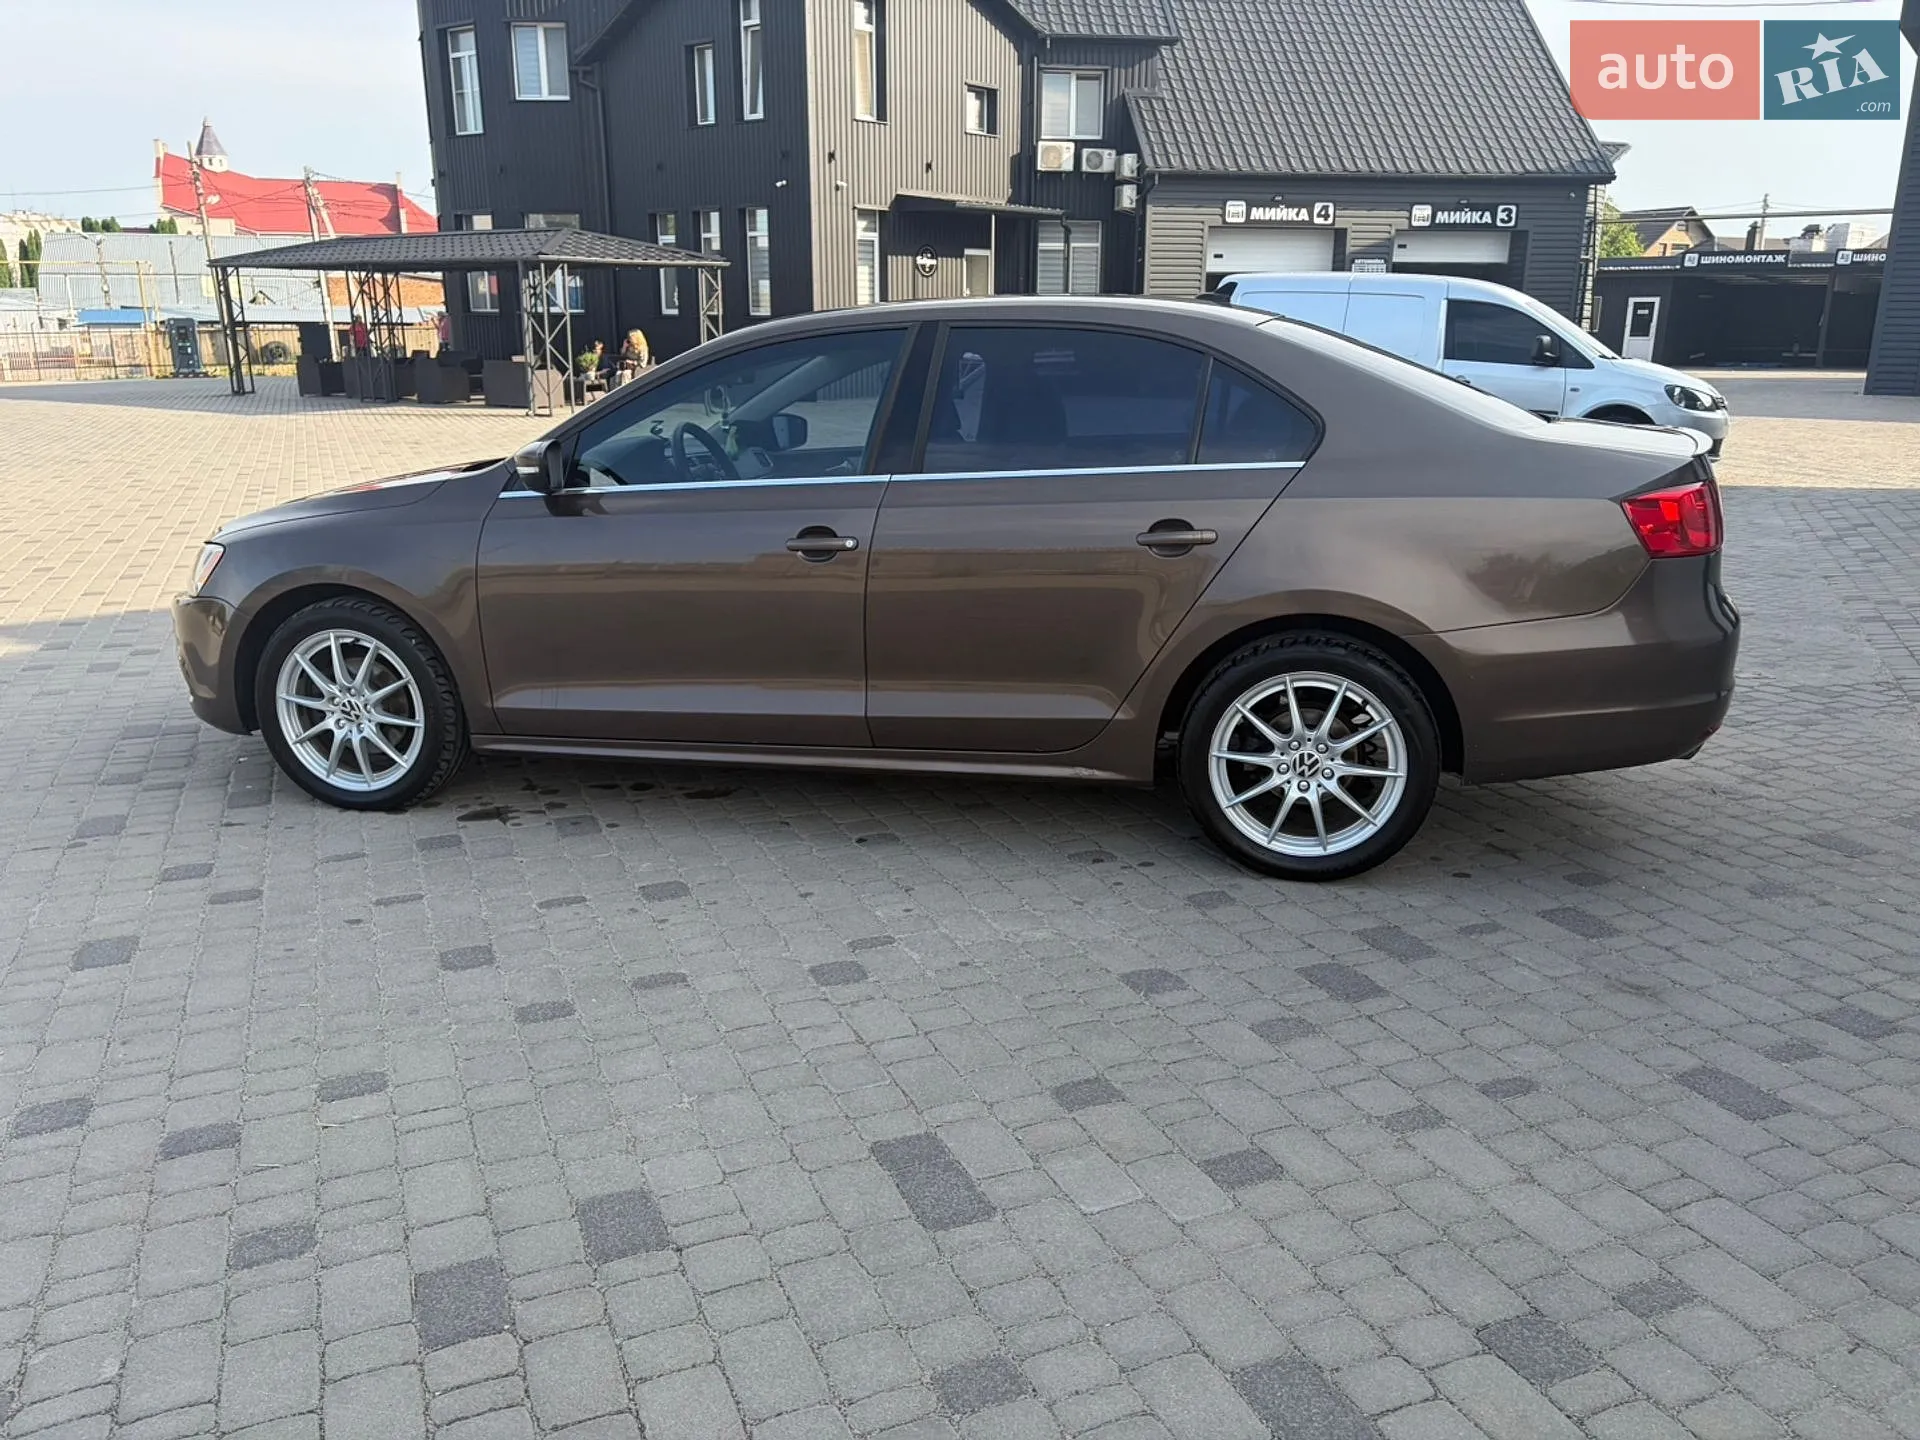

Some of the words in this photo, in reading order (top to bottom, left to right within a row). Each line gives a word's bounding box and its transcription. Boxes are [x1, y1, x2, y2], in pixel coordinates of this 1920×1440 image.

[1250, 204, 1309, 221] МИЙКА
[1316, 205, 1331, 221] 4
[1435, 208, 1492, 224] МИЙКА
[1500, 207, 1514, 224] 3
[1700, 254, 1786, 264] ШИНОМОНТАЖ
